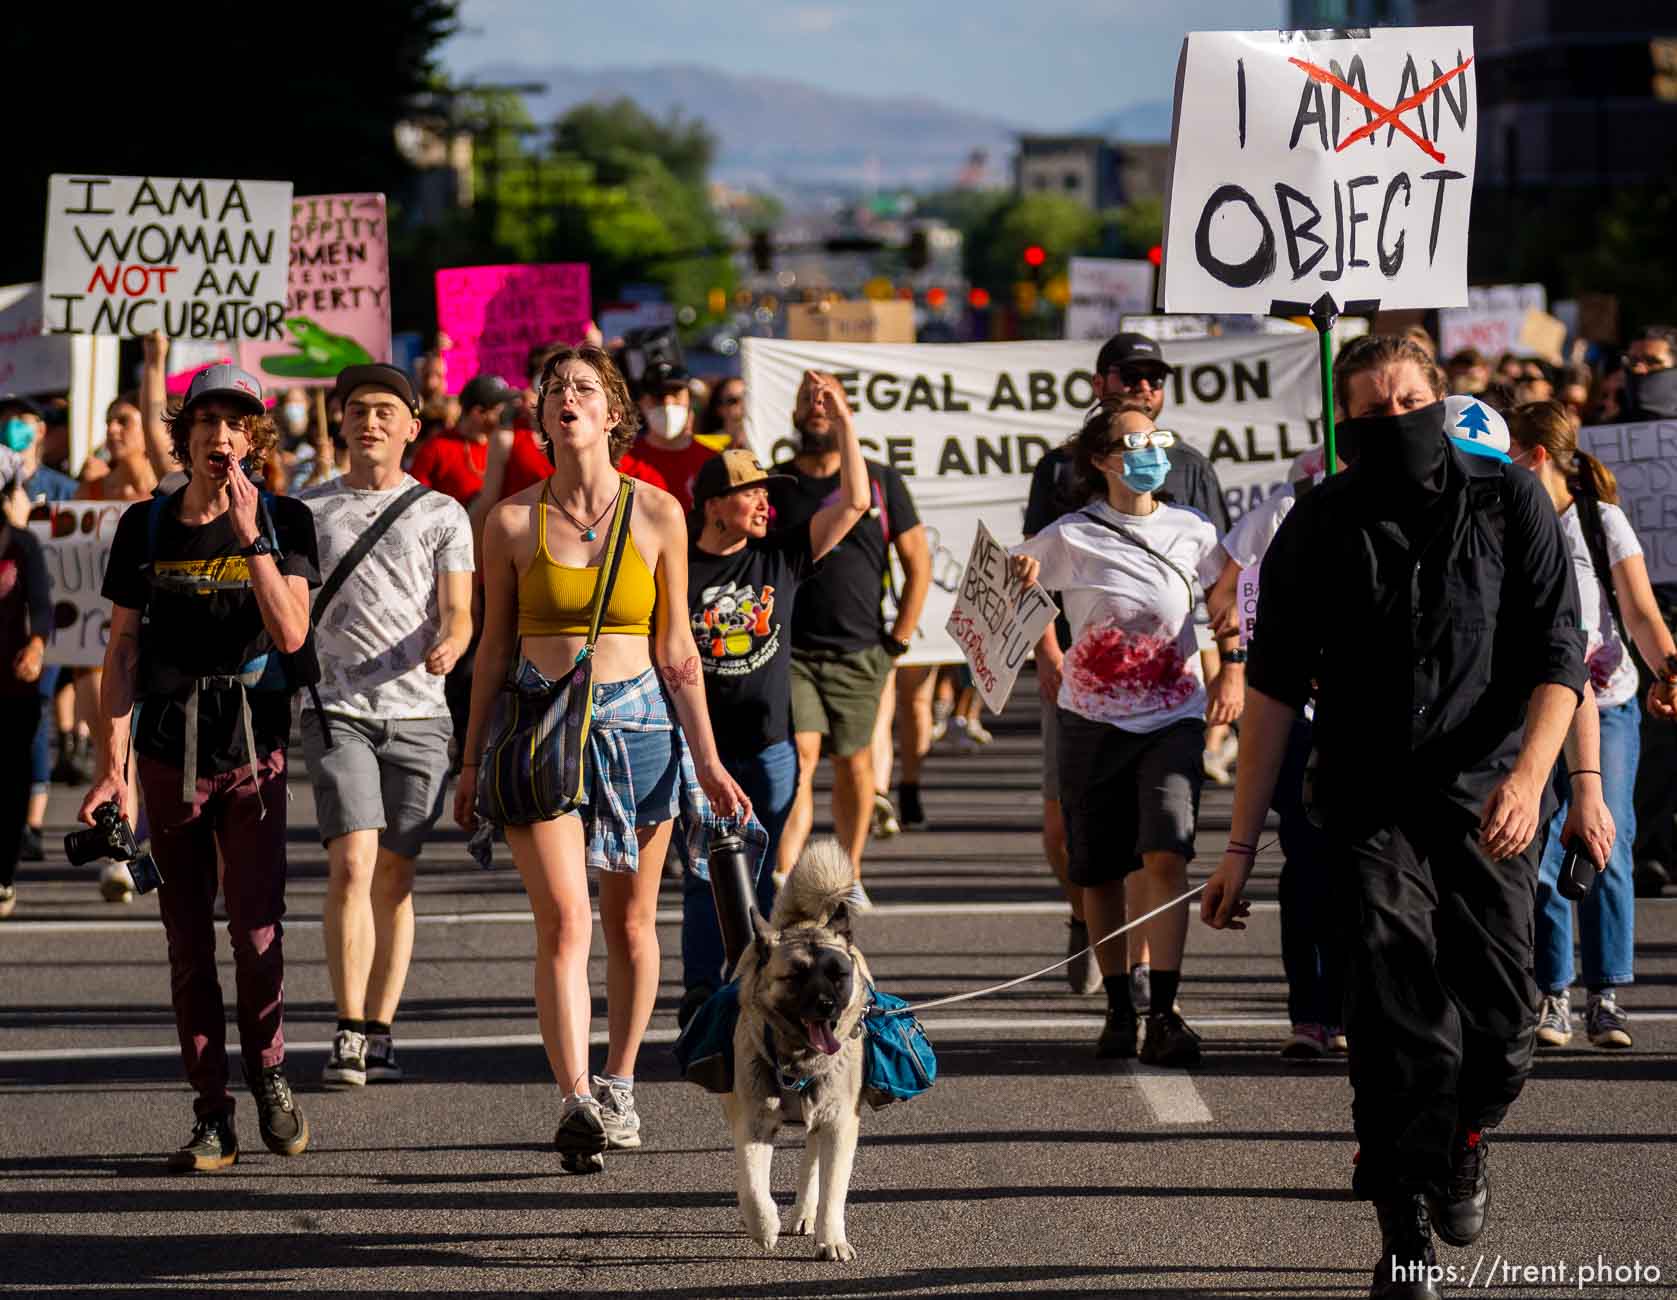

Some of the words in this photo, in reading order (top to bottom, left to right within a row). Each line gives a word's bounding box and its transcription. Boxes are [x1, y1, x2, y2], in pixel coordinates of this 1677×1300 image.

[1237, 57, 1247, 149] I
[1289, 53, 1375, 150] AM
[1387, 48, 1468, 148] AN
[64, 178, 115, 214] I
[128, 176, 209, 220] AM
[218, 179, 252, 223] A
[74, 224, 275, 266] WOMAN
[290, 217, 382, 243] OPPITY
[1194, 170, 1467, 288] OBJECT
[87, 264, 178, 297] NOT
[193, 267, 260, 297] AN
[49, 294, 285, 341] INCUBATOR
[835, 370, 971, 412] EGAL
[987, 359, 1272, 412] ABOION
[938, 434, 1050, 476] AND
[973, 534, 999, 580] WE
